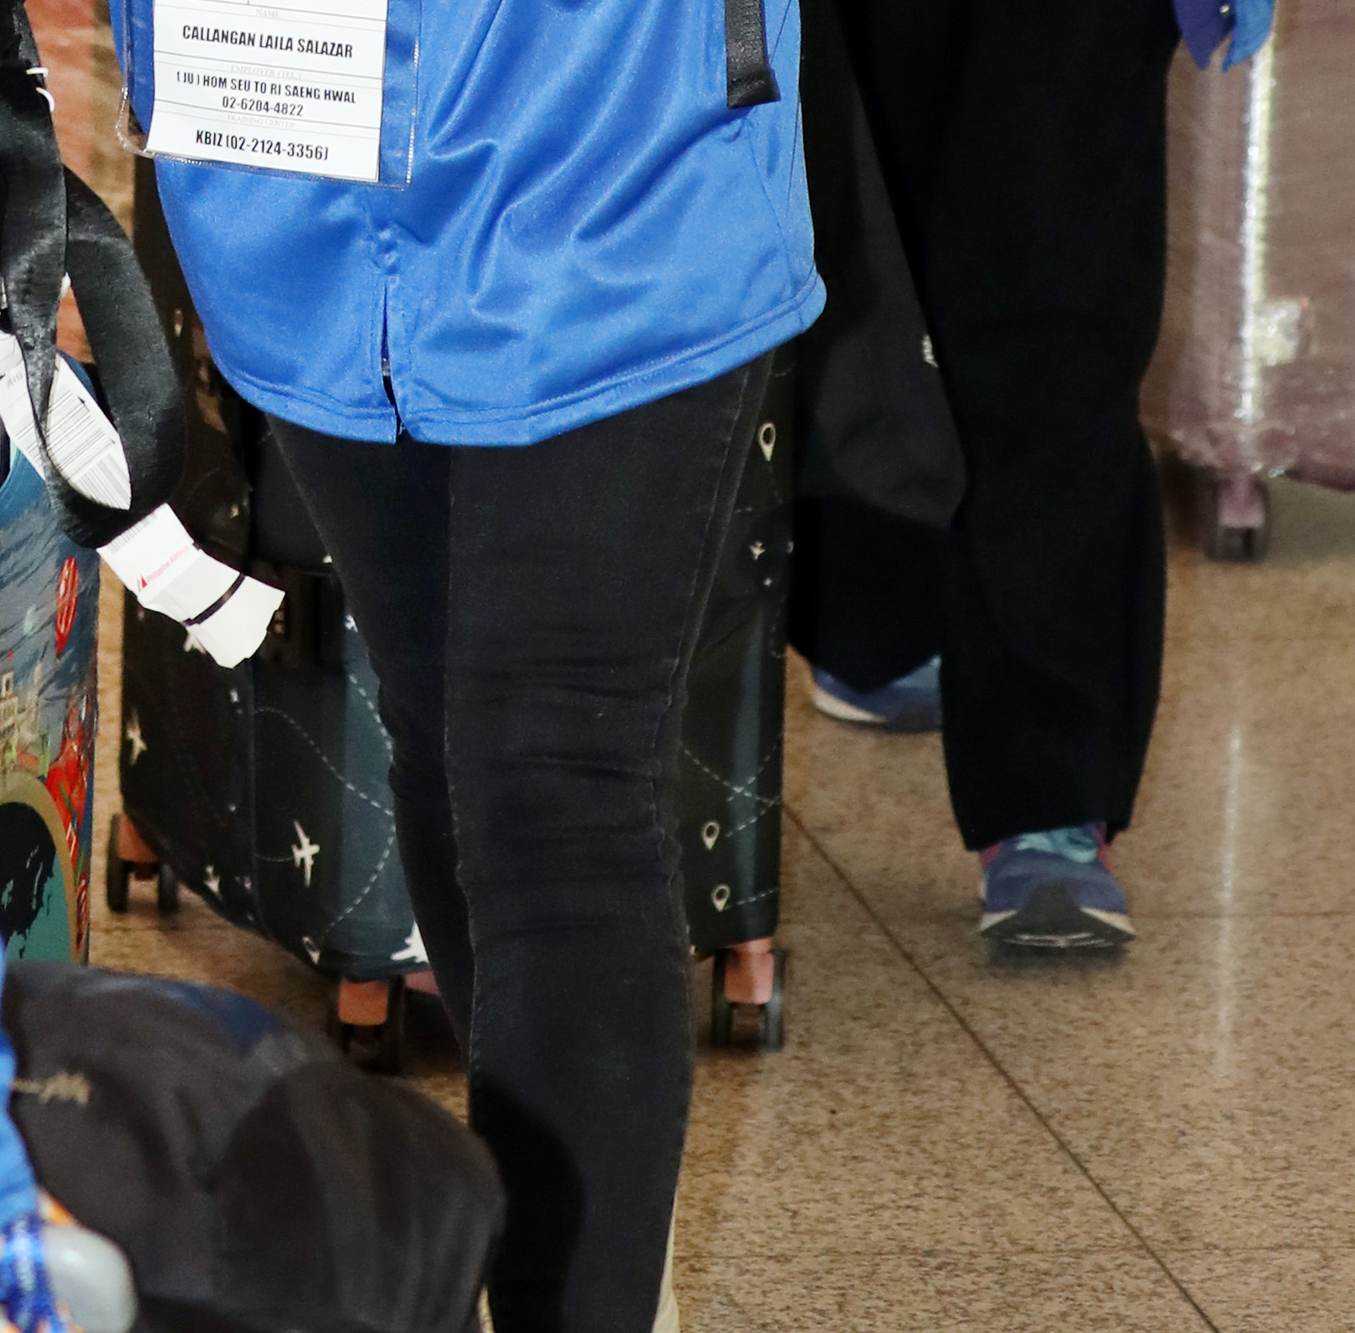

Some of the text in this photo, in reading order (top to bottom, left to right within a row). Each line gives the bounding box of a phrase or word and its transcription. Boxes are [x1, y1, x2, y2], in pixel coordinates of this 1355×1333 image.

[255, 8, 282, 19] NAME
[182, 25, 353, 58] CALLANGAN LAILA SALAZAR
[230, 64, 275, 78] EMPLOYER
[203, 75, 227, 88] HOM
[230, 78, 251, 91] SEU
[254, 81, 267, 93] TO
[270, 83, 281, 95] RI
[284, 84, 321, 100] SAENG
[324, 89, 356, 103] HWAL
[222, 96, 304, 116] 02-6204-4822
[227, 113, 296, 129] TRAINING CENTER
[196, 130, 329, 161] KBIZ (02-2124-3356)
